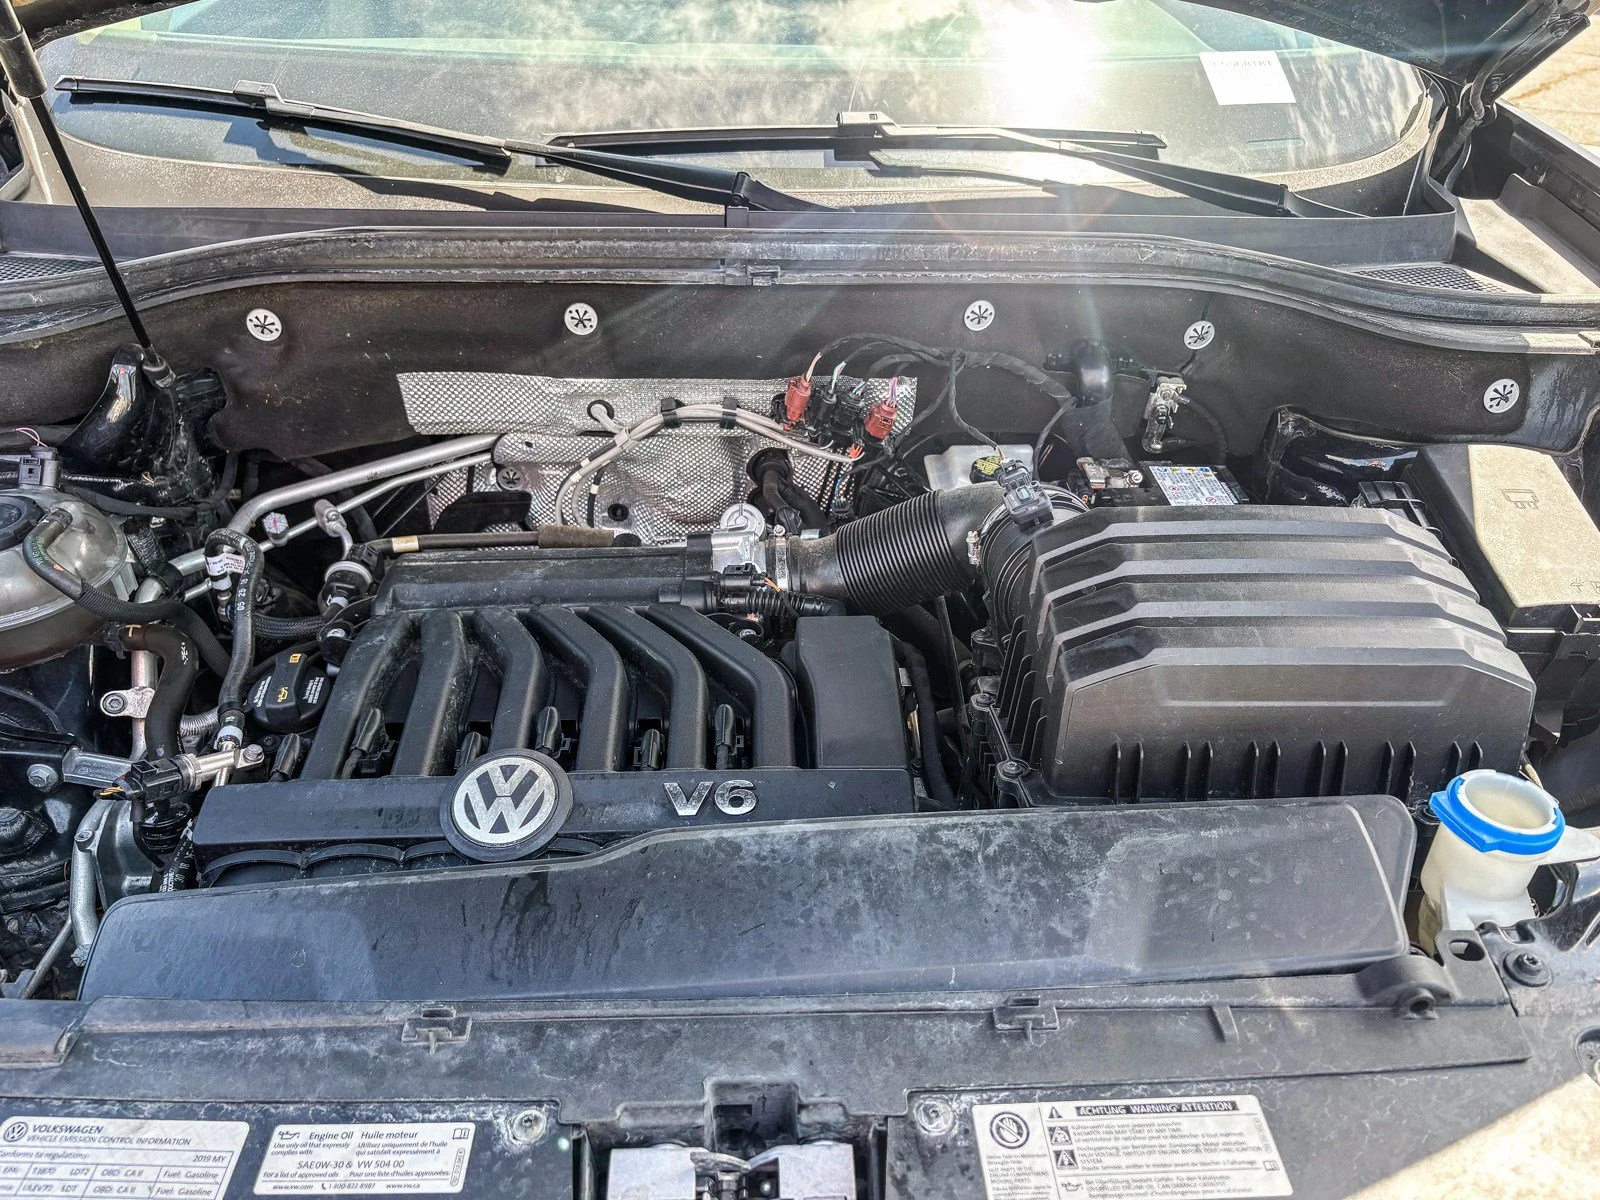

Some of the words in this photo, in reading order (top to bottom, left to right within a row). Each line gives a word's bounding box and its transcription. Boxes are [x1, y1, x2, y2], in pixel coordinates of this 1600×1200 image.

[662, 779, 758, 816] V6
[1079, 1106, 1126, 1116] ACHTUNG
[1130, 1104, 1178, 1114] WARNING
[1180, 1101, 1233, 1112] ATTENTION
[32, 1124, 104, 1134] VOLKSWAGEN
[309, 1132, 339, 1140] Engine
[360, 1131, 384, 1139] Huile
